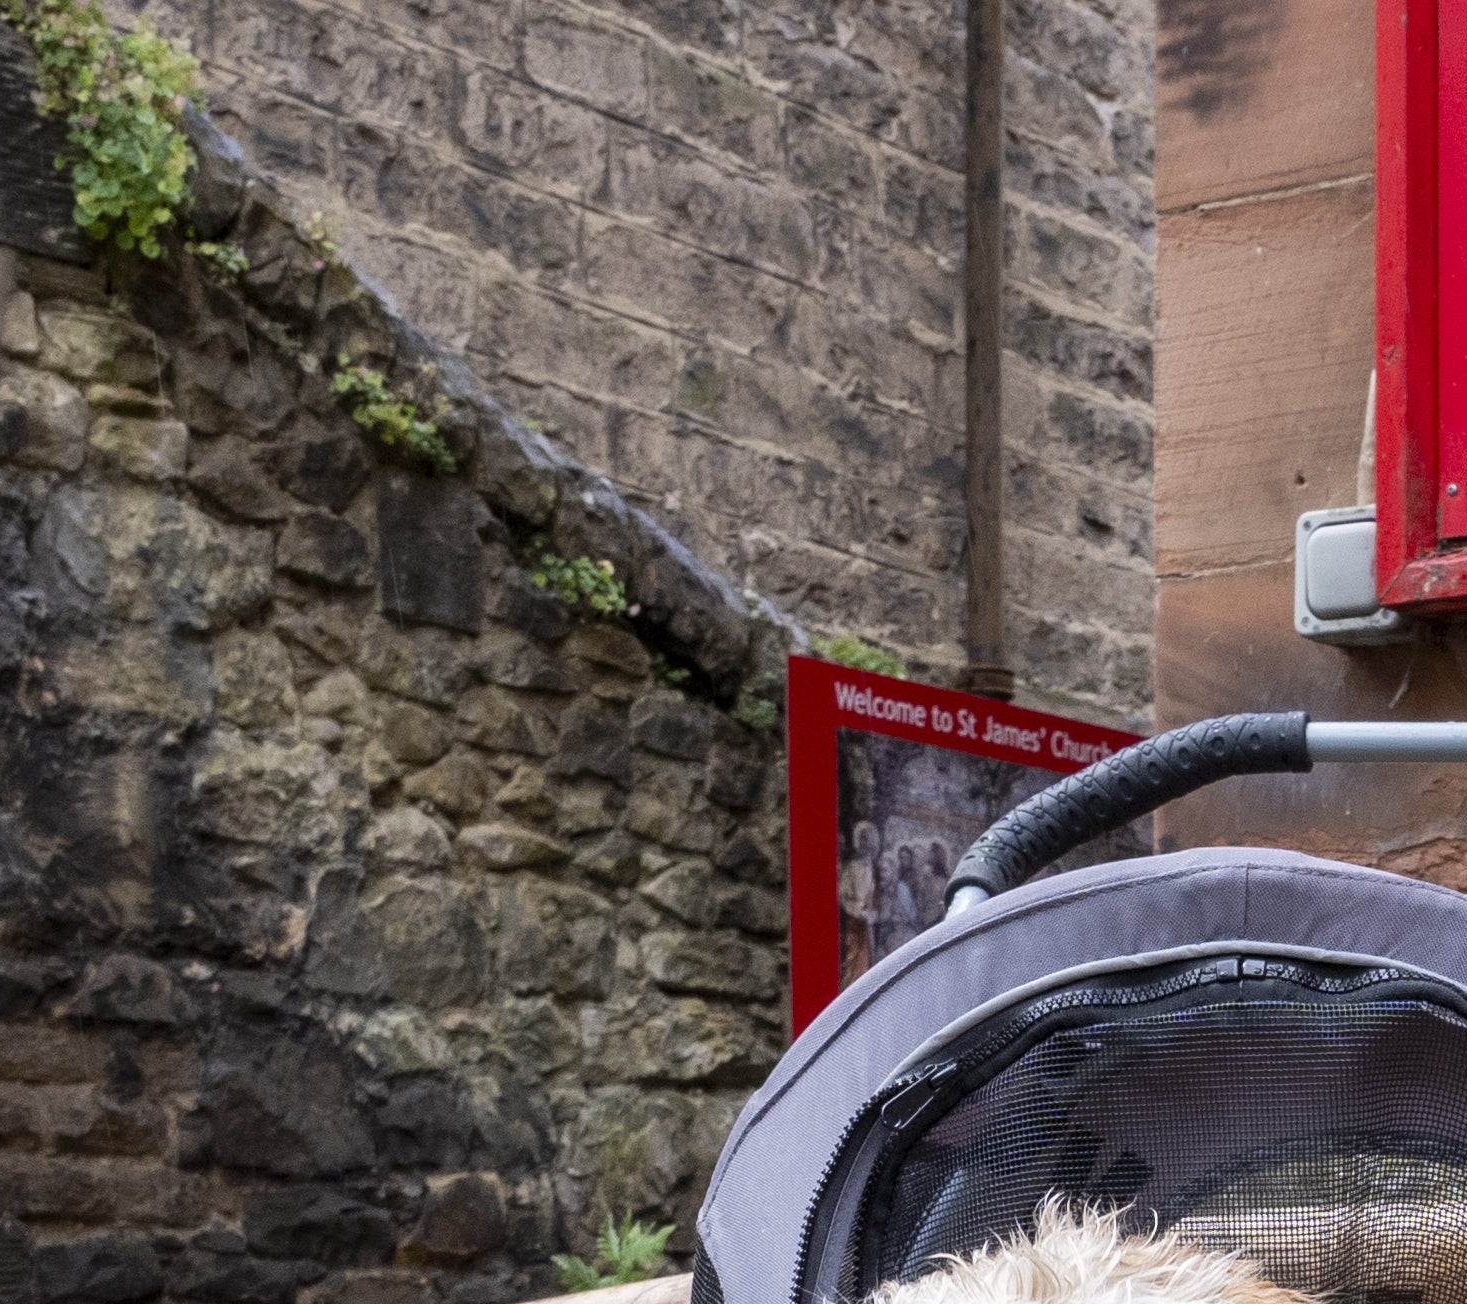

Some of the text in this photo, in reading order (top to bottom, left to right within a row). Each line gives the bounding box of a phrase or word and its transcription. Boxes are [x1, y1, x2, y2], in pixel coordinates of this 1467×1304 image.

[834, 681, 927, 727] Welcome
[931, 705, 953, 733] to
[957, 708, 978, 740] St
